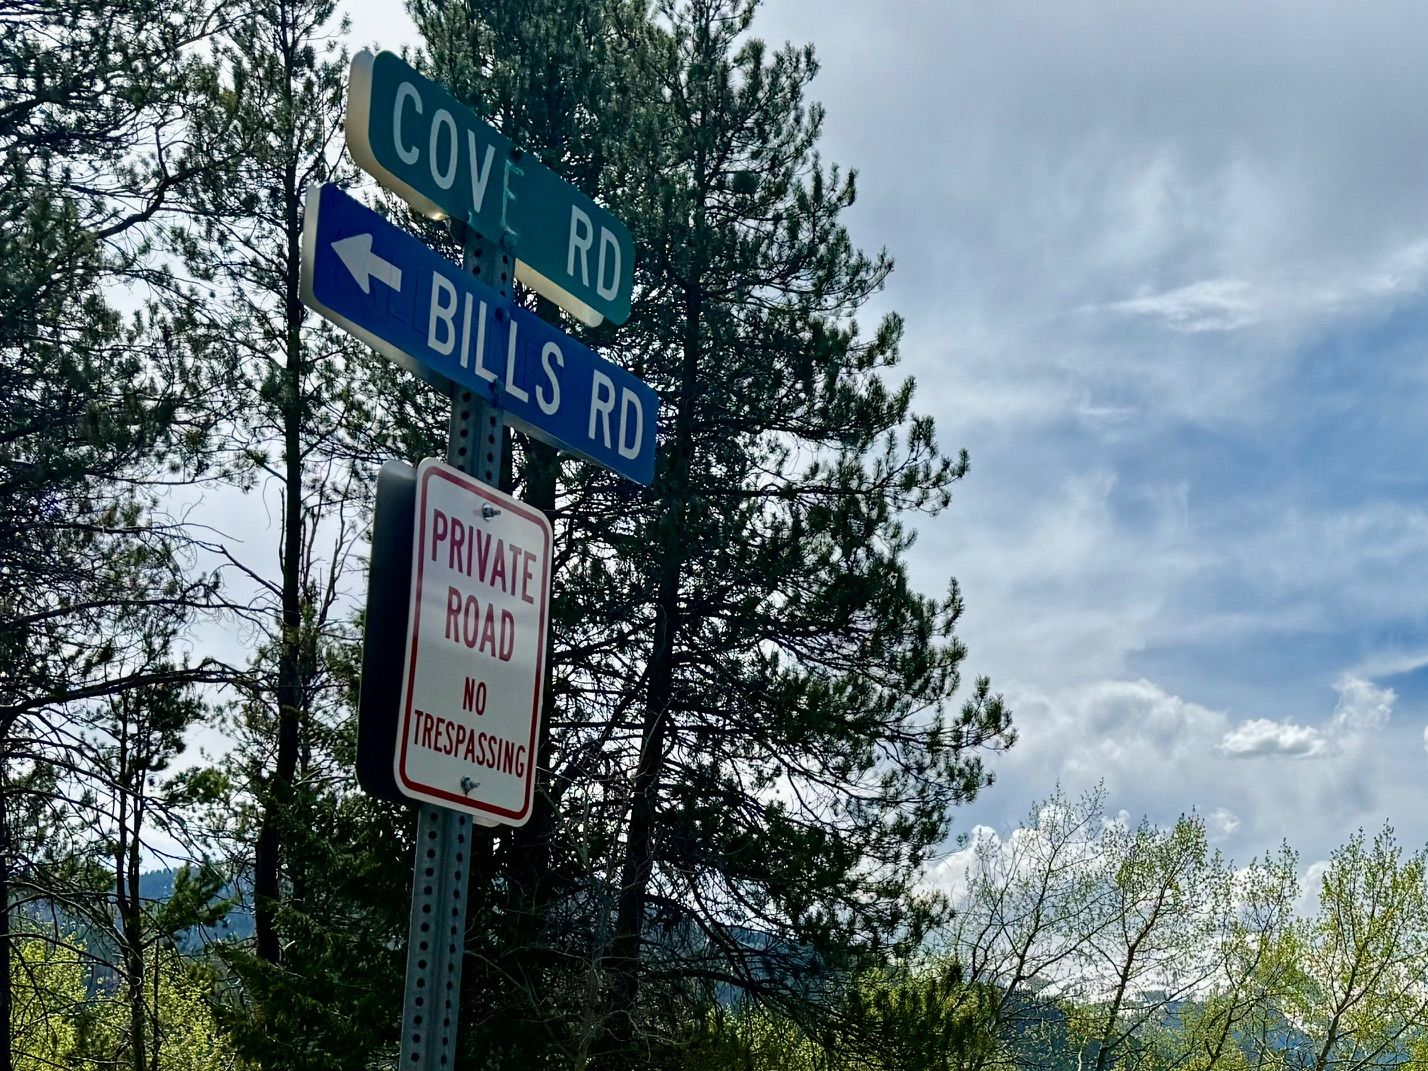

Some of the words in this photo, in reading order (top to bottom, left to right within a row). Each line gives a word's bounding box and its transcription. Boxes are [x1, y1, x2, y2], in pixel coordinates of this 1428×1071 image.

[393, 81, 524, 240] COVE
[567, 204, 622, 302] RD
[427, 270, 565, 416] BILLS
[588, 369, 644, 460] RD
[431, 508, 537, 605] PRIVATE
[445, 585, 515, 662] ROAD
[462, 676, 487, 716] NO
[413, 709, 526, 779] TRESPASSING
